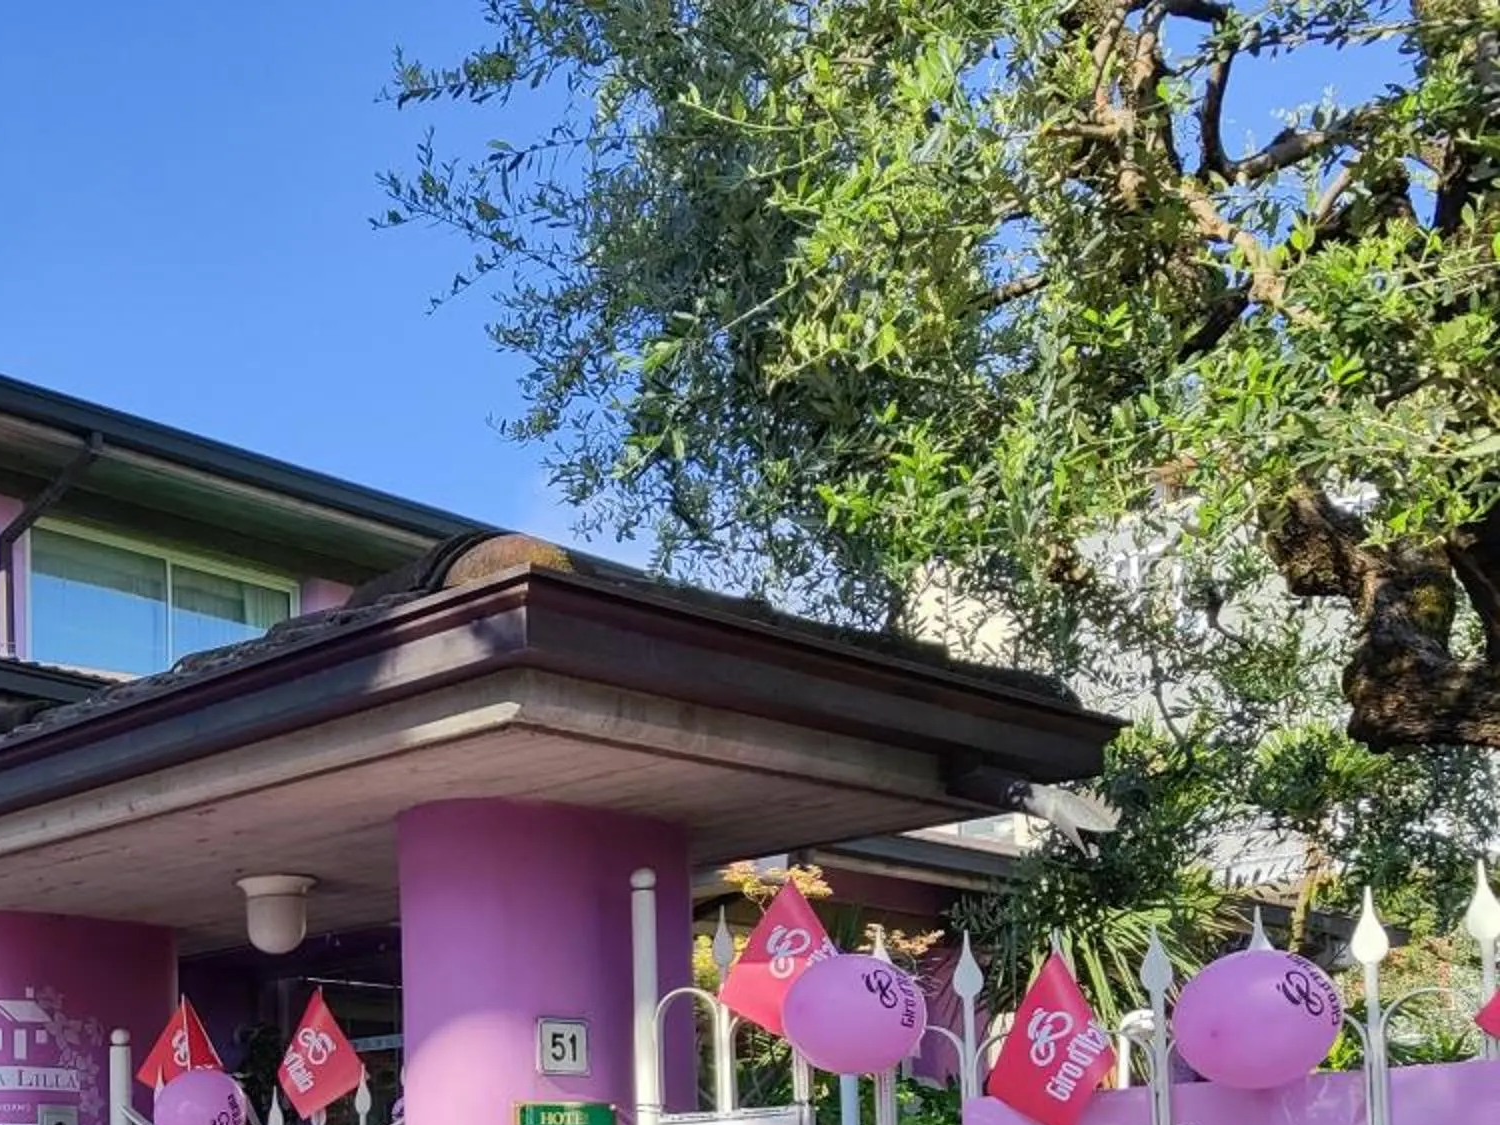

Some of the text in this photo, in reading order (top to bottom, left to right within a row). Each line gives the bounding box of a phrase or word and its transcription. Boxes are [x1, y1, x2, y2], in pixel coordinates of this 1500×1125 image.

[551, 1033, 577, 1062] 51
[18, 1069, 78, 1088] LILLA
[1045, 1061, 1085, 1102] Giro
